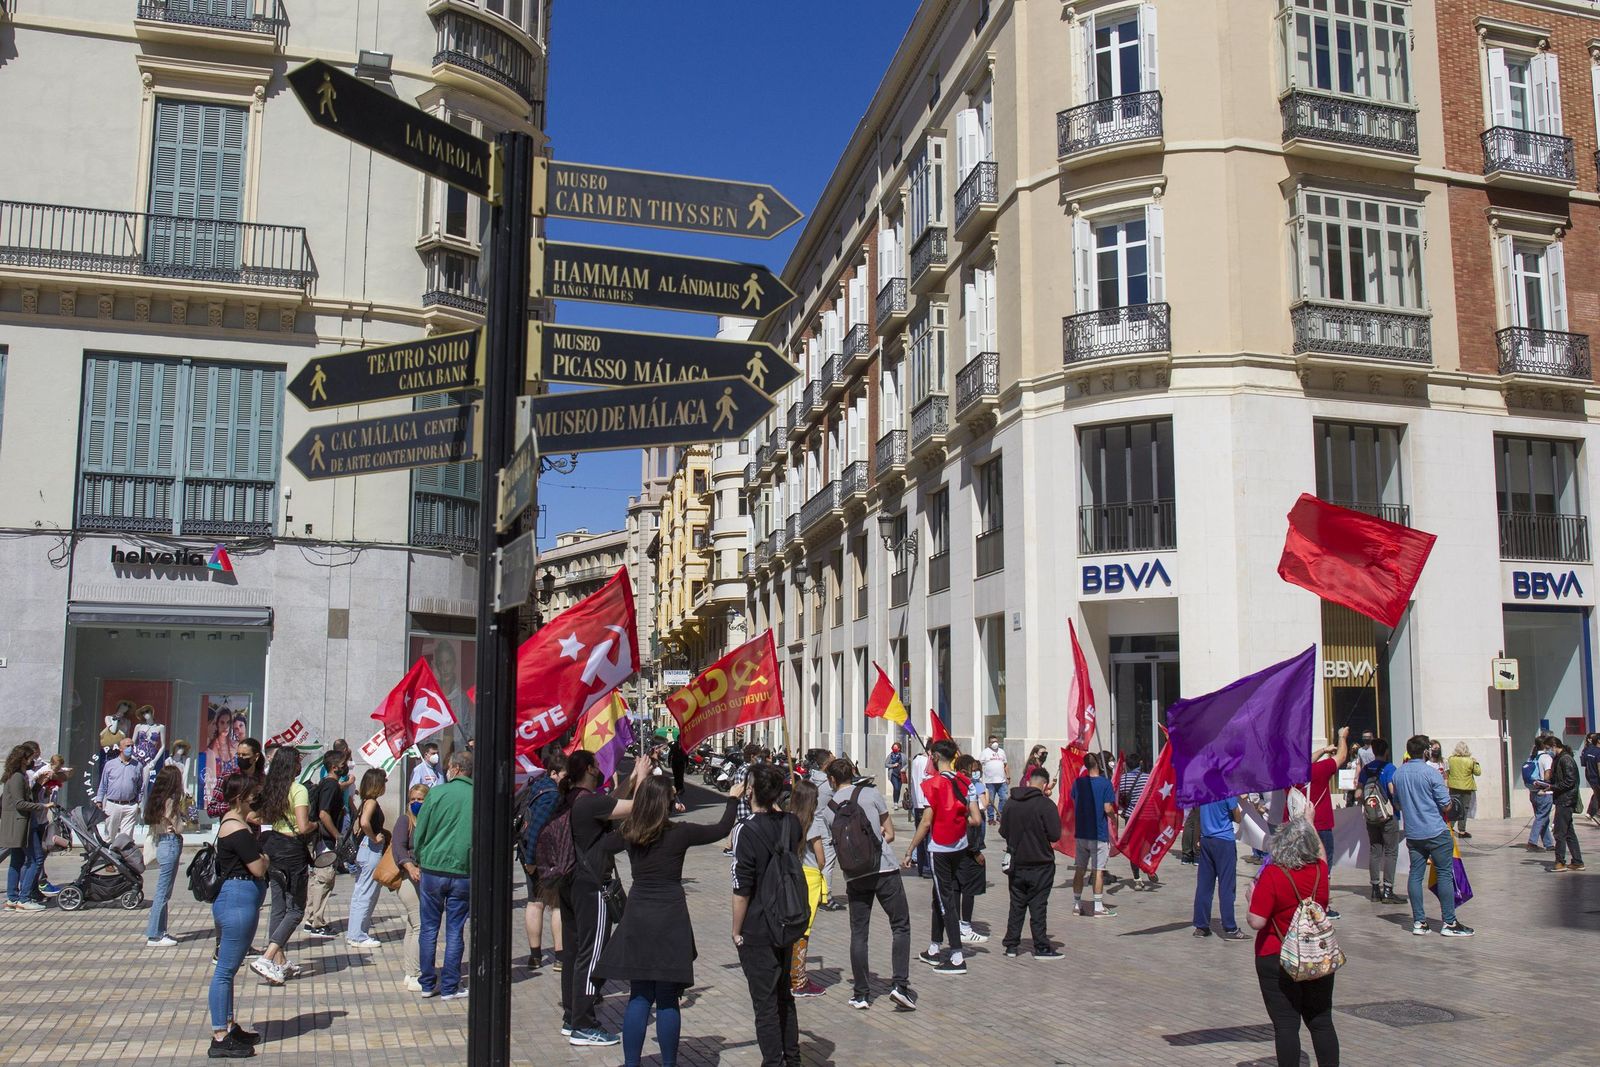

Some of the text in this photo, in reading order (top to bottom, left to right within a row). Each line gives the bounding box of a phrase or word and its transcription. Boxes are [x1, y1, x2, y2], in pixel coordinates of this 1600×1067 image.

[405, 123, 483, 178] LA FAROLA
[556, 170, 608, 191] MUSEO
[555, 190, 738, 229] CARMEN THYSSEN
[553, 259, 740, 300] HAMMAM AL ÁNDALUS
[553, 282, 634, 302] BAÑOS ÁRABES
[367, 339, 470, 375] TEATRO SOHO
[553, 333, 600, 352] MUSEO
[398, 364, 468, 390] CAIXA BANK
[552, 354, 709, 384] PICASSO MÁLAGA
[331, 416, 467, 451] CAC MÁLAGA CENTRO
[535, 396, 709, 437] MUSEO DE MÁLAGA
[330, 440, 467, 473] DE ARTE CONTEMPORÁNEO
[111, 545, 204, 566] helvetia
[1082, 558, 1172, 594] BBVA
[1513, 570, 1584, 600] BBVA
[1323, 659, 1374, 678] BBVA
[515, 704, 568, 740] CTE
[1142, 825, 1175, 866] PCTE
